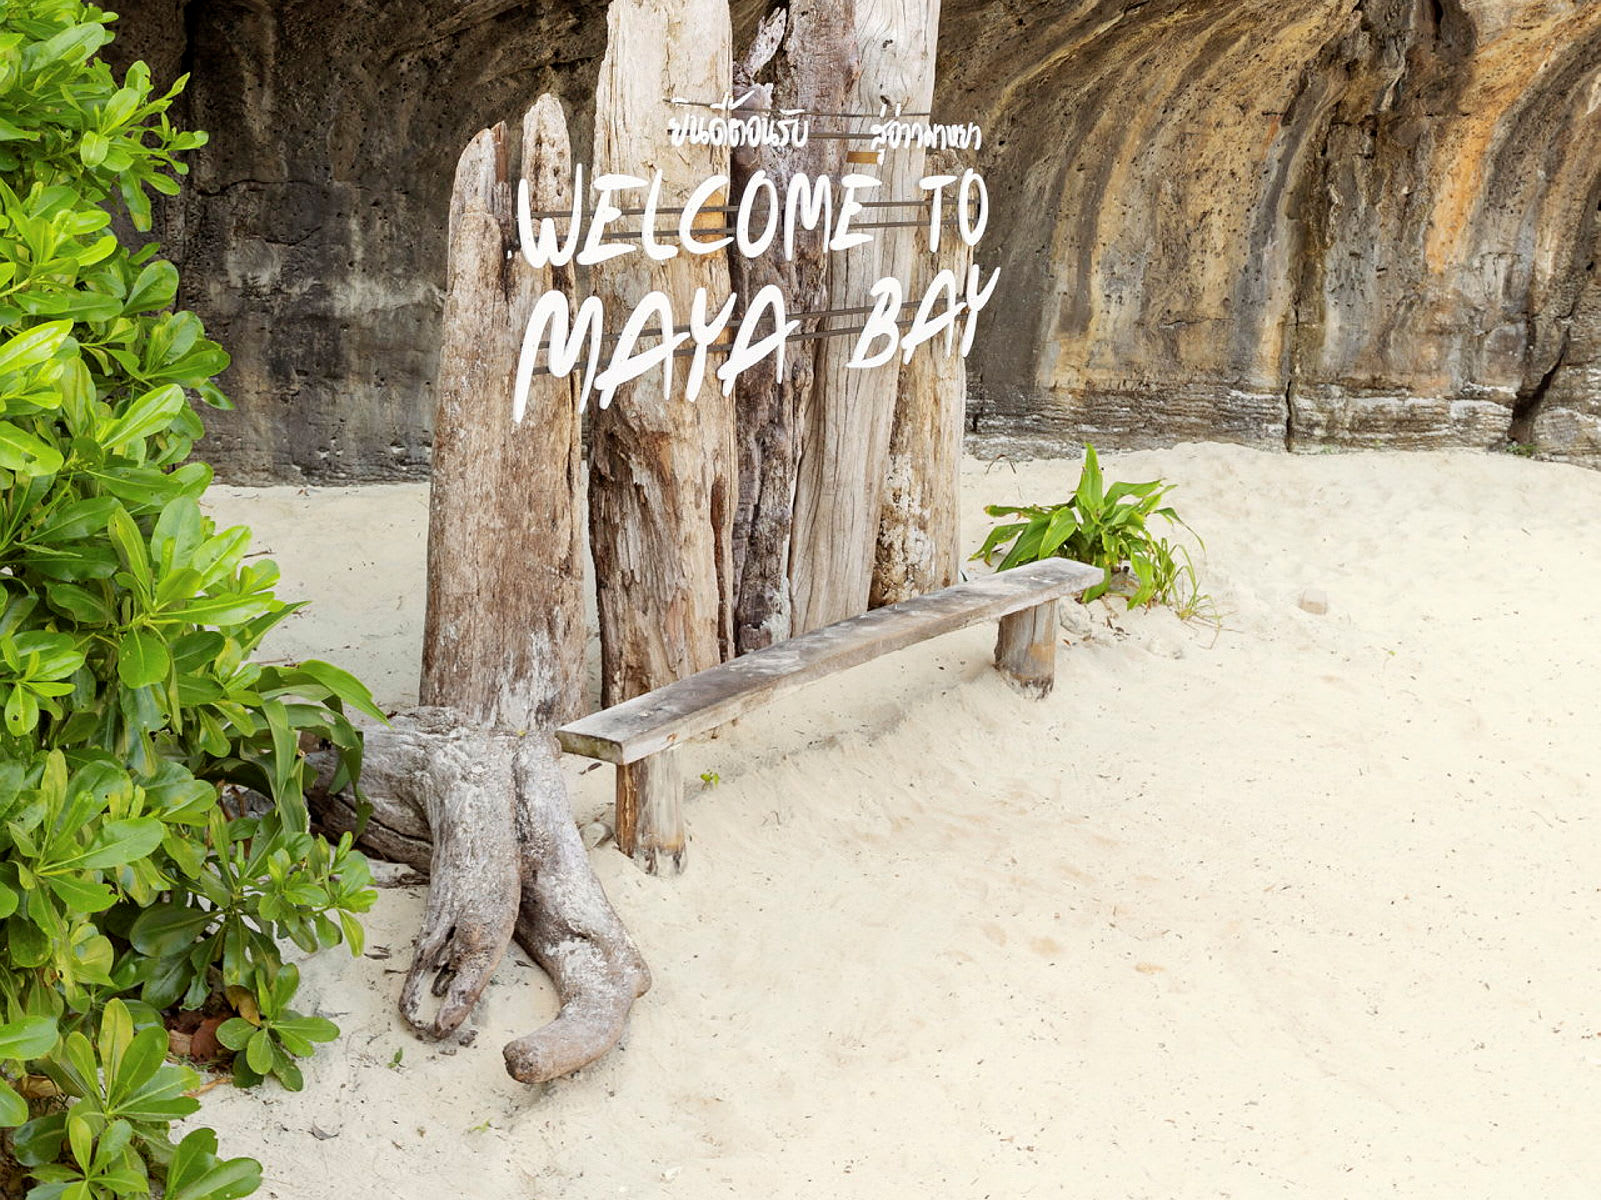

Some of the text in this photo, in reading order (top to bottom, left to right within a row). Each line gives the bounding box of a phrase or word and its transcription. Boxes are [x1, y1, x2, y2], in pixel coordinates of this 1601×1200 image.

[518, 163, 989, 268] WELCOME TO
[513, 263, 1001, 424] MAYA BAY
